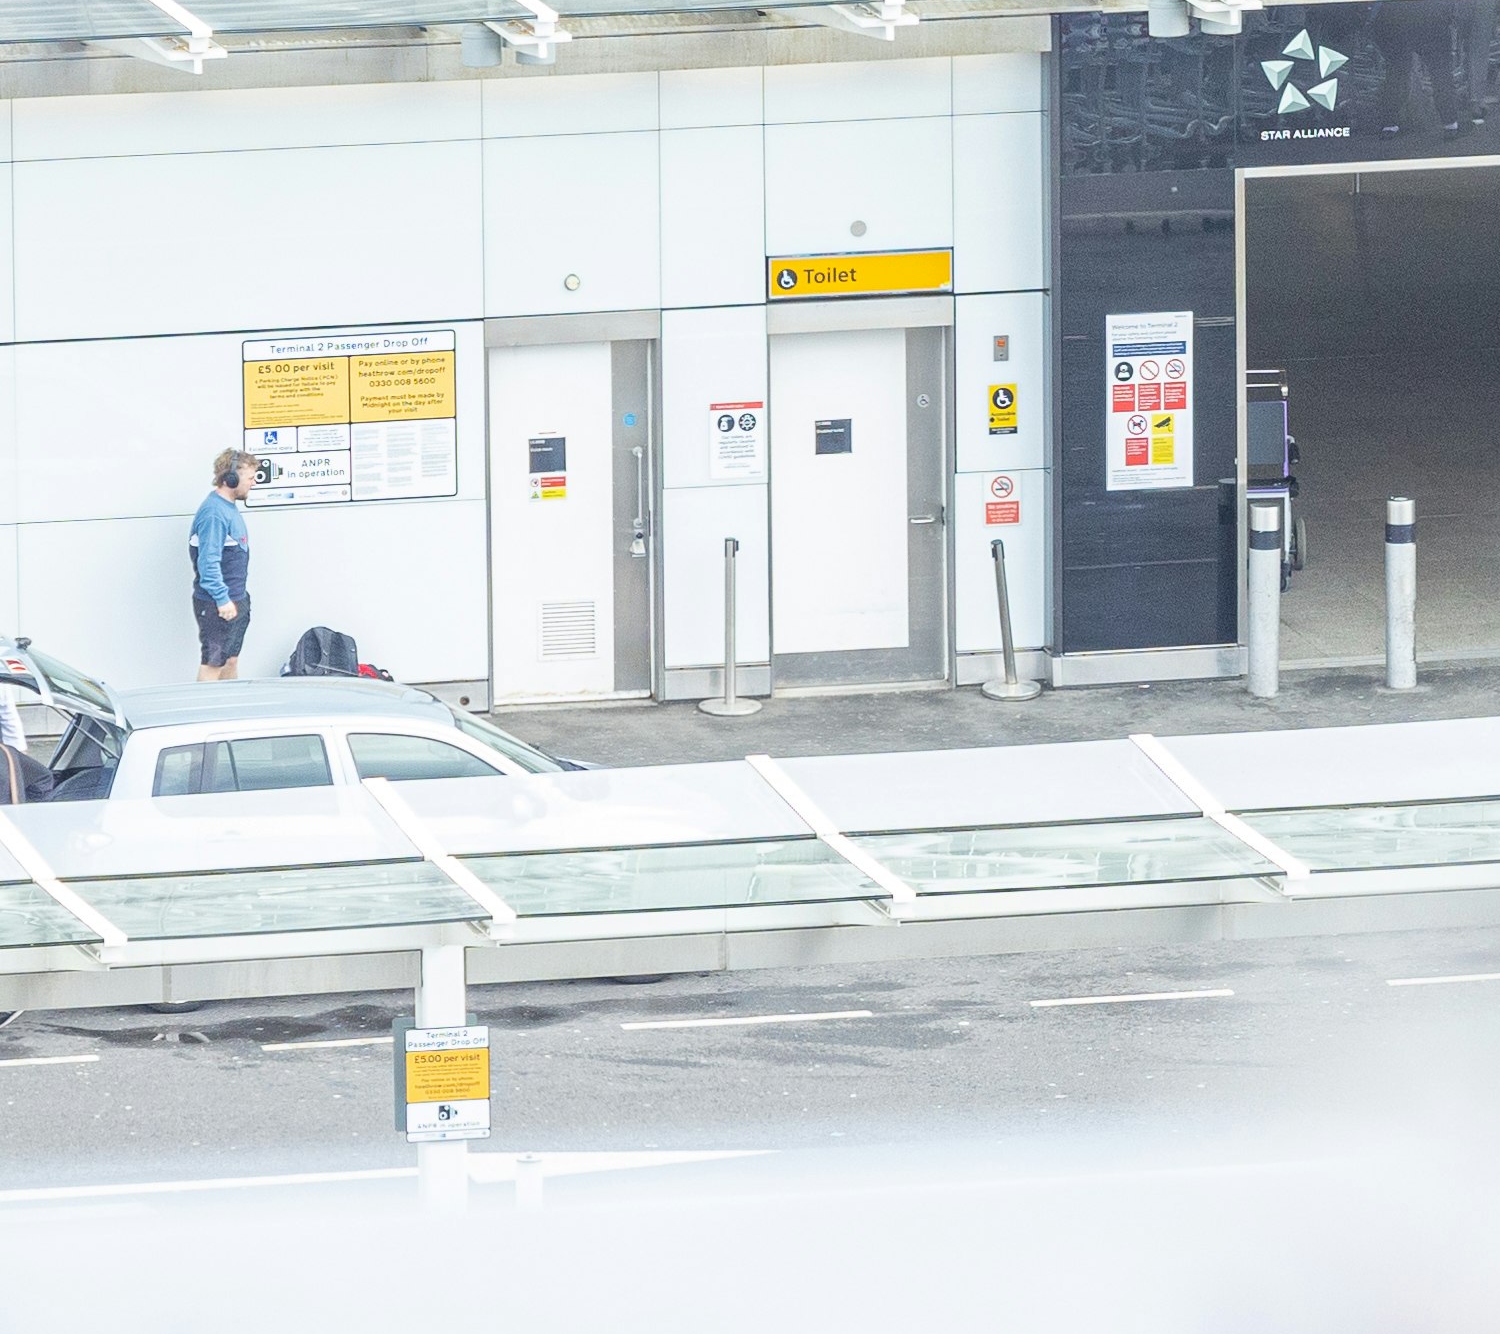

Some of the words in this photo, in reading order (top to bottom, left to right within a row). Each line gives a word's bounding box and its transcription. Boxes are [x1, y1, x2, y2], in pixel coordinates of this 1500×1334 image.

[1260, 130, 1291, 141] STAR
[1293, 127, 1351, 139] ALLIANCE
[804, 268, 857, 284] Toilet
[270, 344, 315, 354] Terminal
[318, 342, 324, 351] 2
[327, 341, 379, 351] Passenger
[383, 339, 408, 348] Drop
[411, 337, 428, 346] Off
[258, 364, 290, 374] £5.00
[293, 365, 309, 373] per
[313, 362, 334, 371] visit
[394, 378, 411, 386] 008
[414, 377, 435, 385] 5600
[302, 459, 330, 467] ANPR
[299, 469, 344, 478] operation
[415, 1054, 441, 1063] £5.00
[444, 1055, 458, 1063] per
